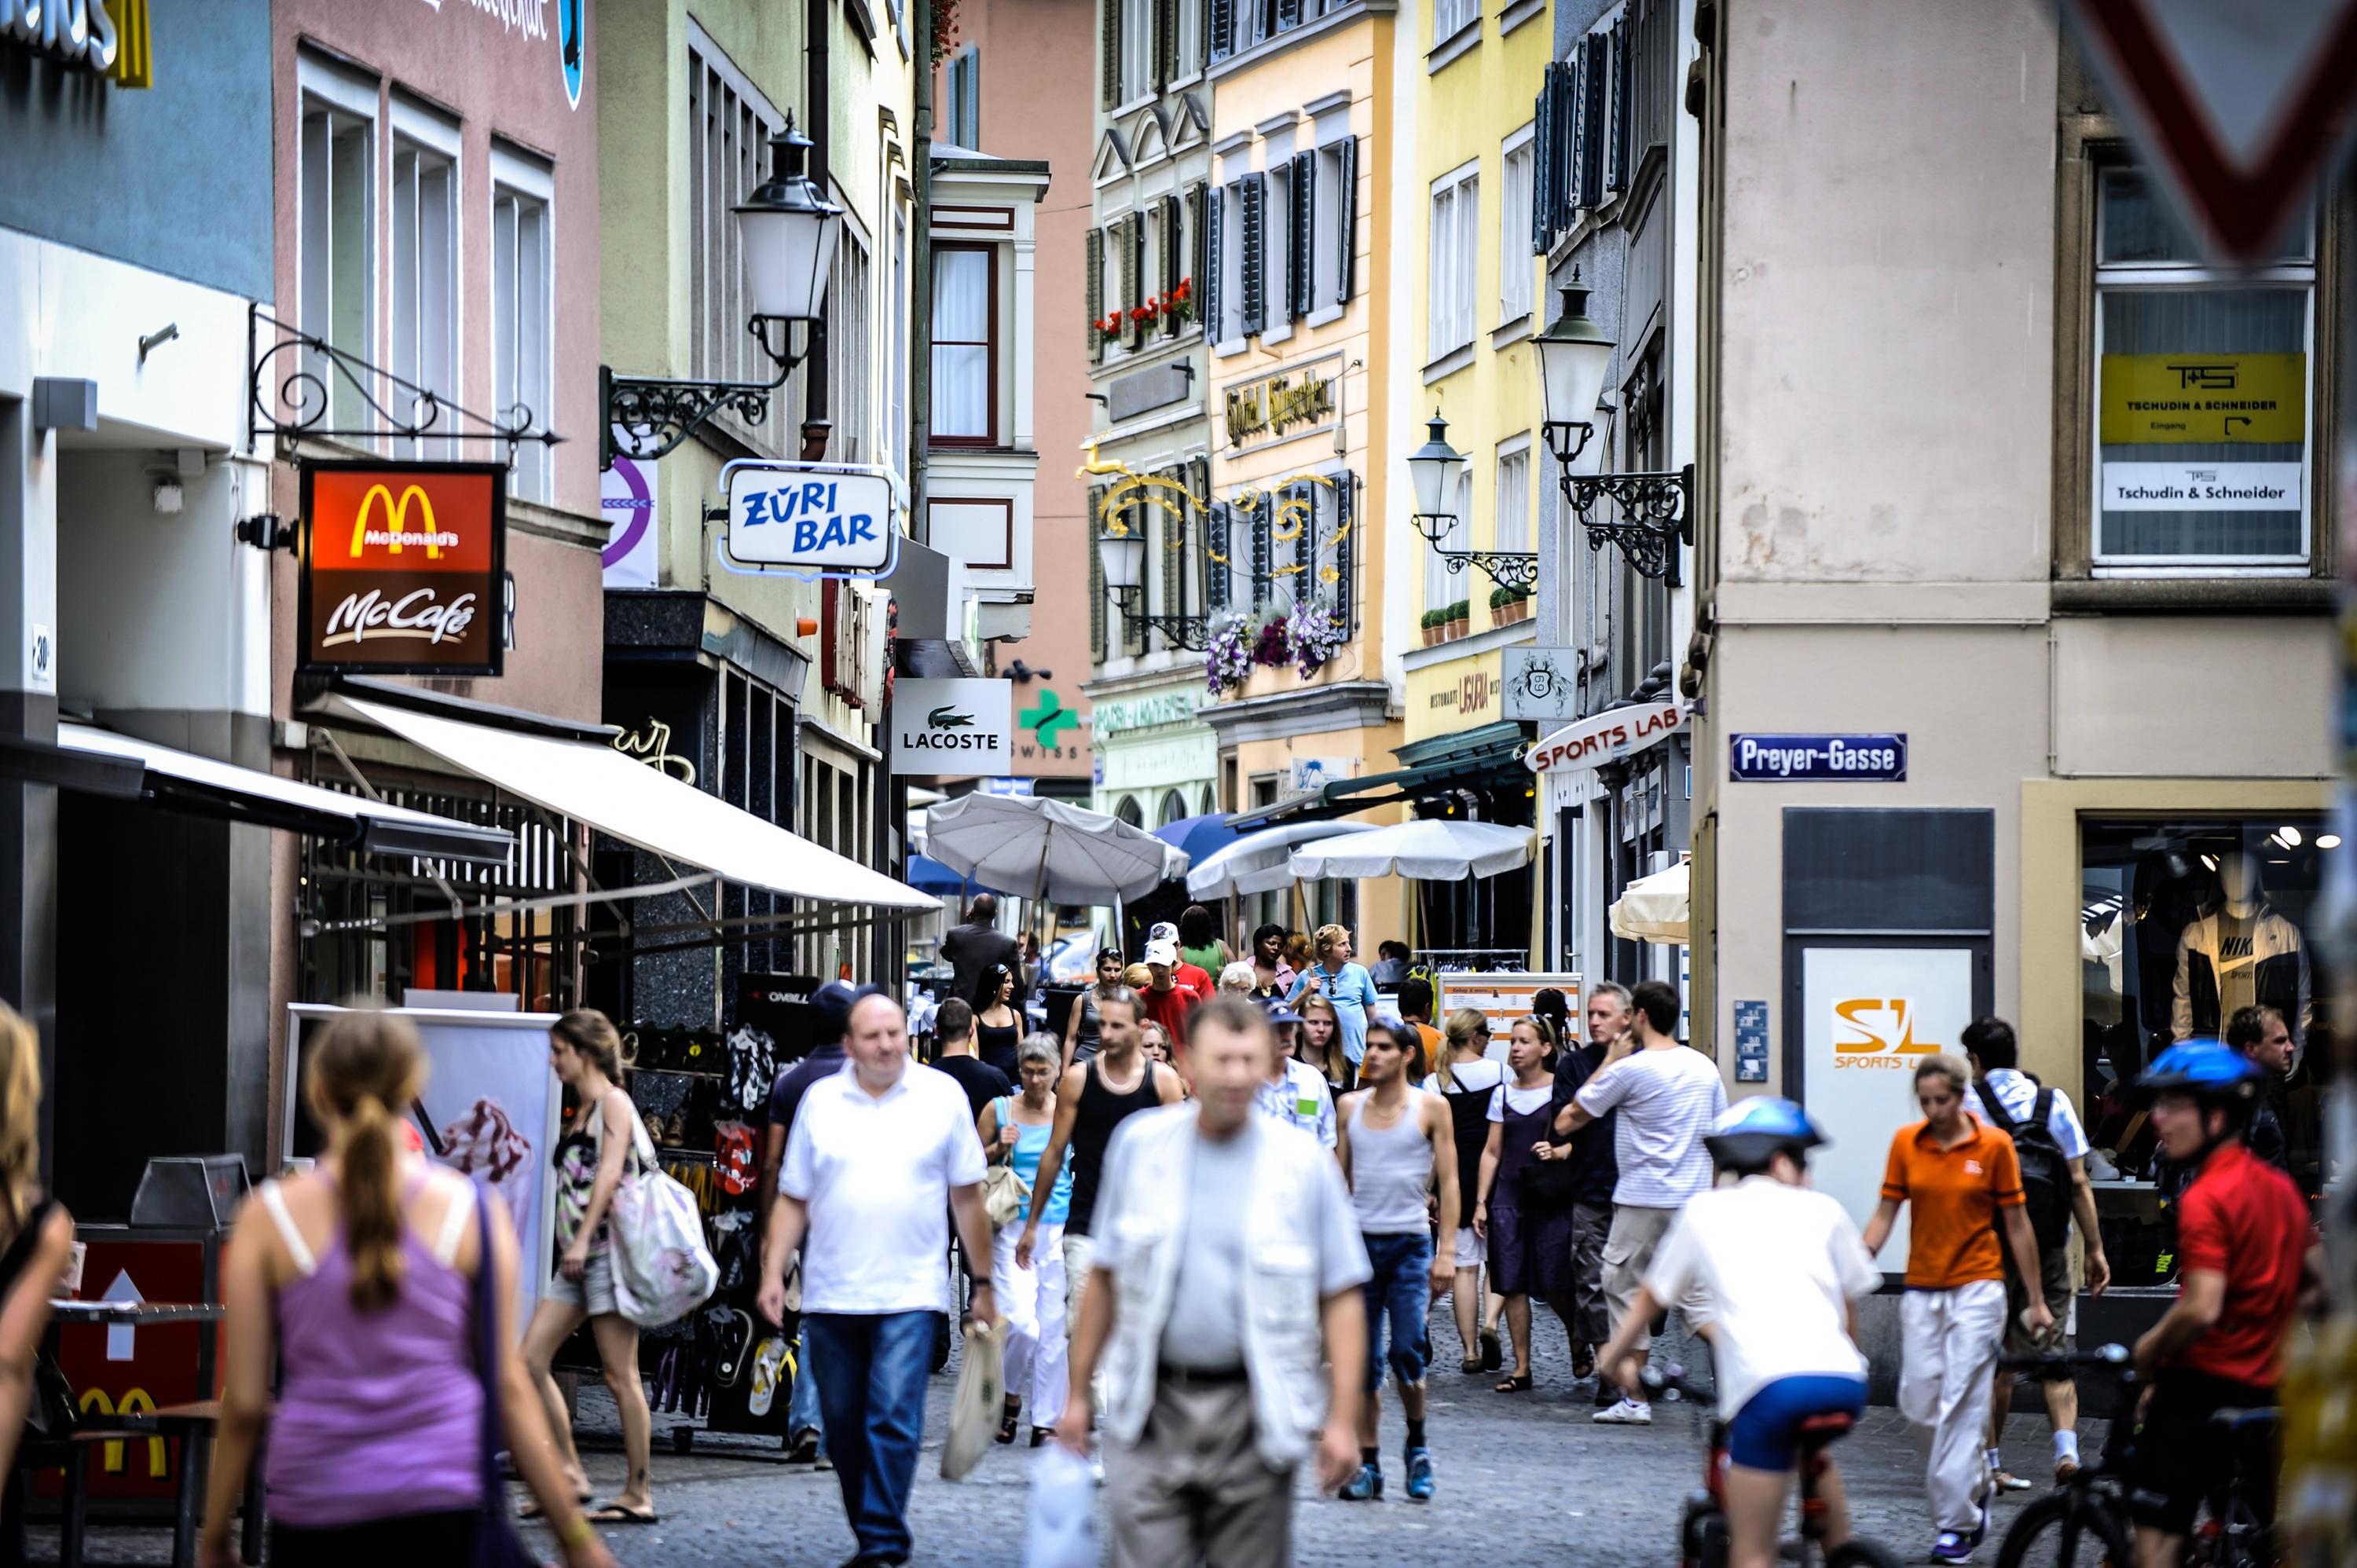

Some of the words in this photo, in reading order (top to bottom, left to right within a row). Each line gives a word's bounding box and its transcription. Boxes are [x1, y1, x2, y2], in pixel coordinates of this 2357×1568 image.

[2127, 401, 2190, 411] TSCHUDIN
[2194, 401, 2201, 411] &
[2205, 401, 2277, 410] SCHNEIDER
[2150, 421, 2187, 431] Eingang
[2118, 486, 2183, 499] Tschudin
[2188, 486, 2200, 499] &
[2206, 486, 2286, 499] Schneider
[364, 529, 459, 548] McDonald's
[793, 514, 879, 553] BAR
[325, 588, 477, 645] McCafé
[37, 635, 47, 671] 30
[904, 733, 999, 749] LACOSTE
[1535, 725, 1627, 771] SPORTS
[1636, 707, 1679, 738] LAB
[1740, 739, 1895, 776] Preyer-Gasse
[2220, 936, 2253, 956] NIK
[1835, 998, 1942, 1053] SL
[1835, 1057, 1902, 1069] SPORTS
